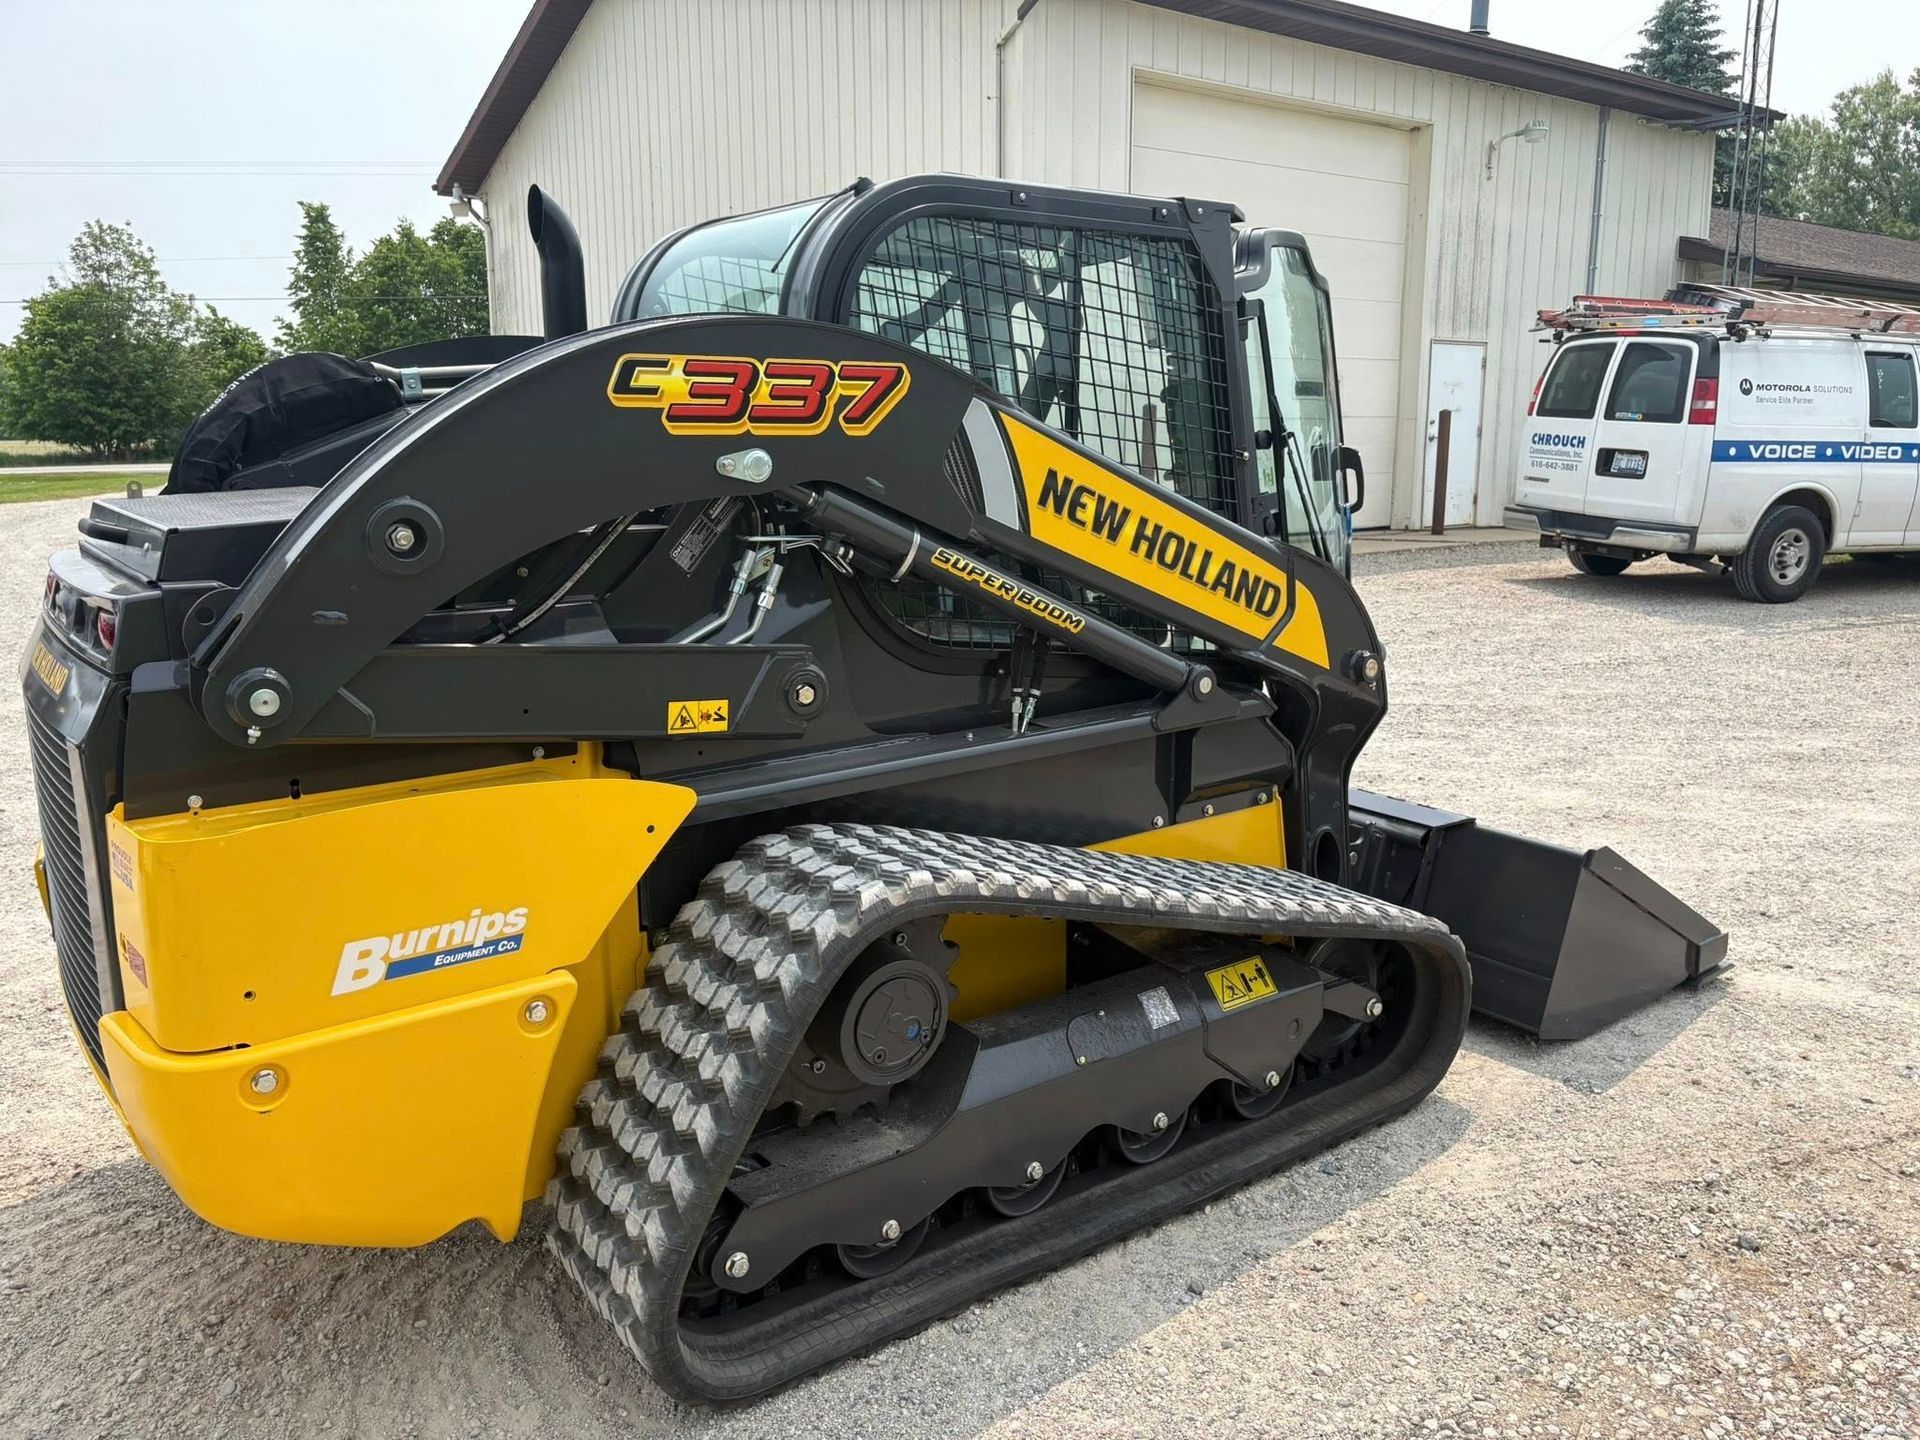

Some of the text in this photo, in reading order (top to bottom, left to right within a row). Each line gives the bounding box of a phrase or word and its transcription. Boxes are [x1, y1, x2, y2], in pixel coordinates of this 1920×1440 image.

[608, 354, 910, 434] C337
[1756, 384, 1853, 394] MOTOROLA SOLUTIONS
[1756, 395, 1777, 404] Service
[1531, 433, 1586, 449] CHROUCH
[1572, 450, 1583, 459] Inc.
[1749, 445, 1902, 460] VOICE VIDEO
[1531, 460, 1578, 472] 616-642-3881
[1037, 467, 1282, 620] NEW HOLLAND
[932, 547, 1085, 634] SUPER BOOM
[331, 907, 528, 996] Burnips
